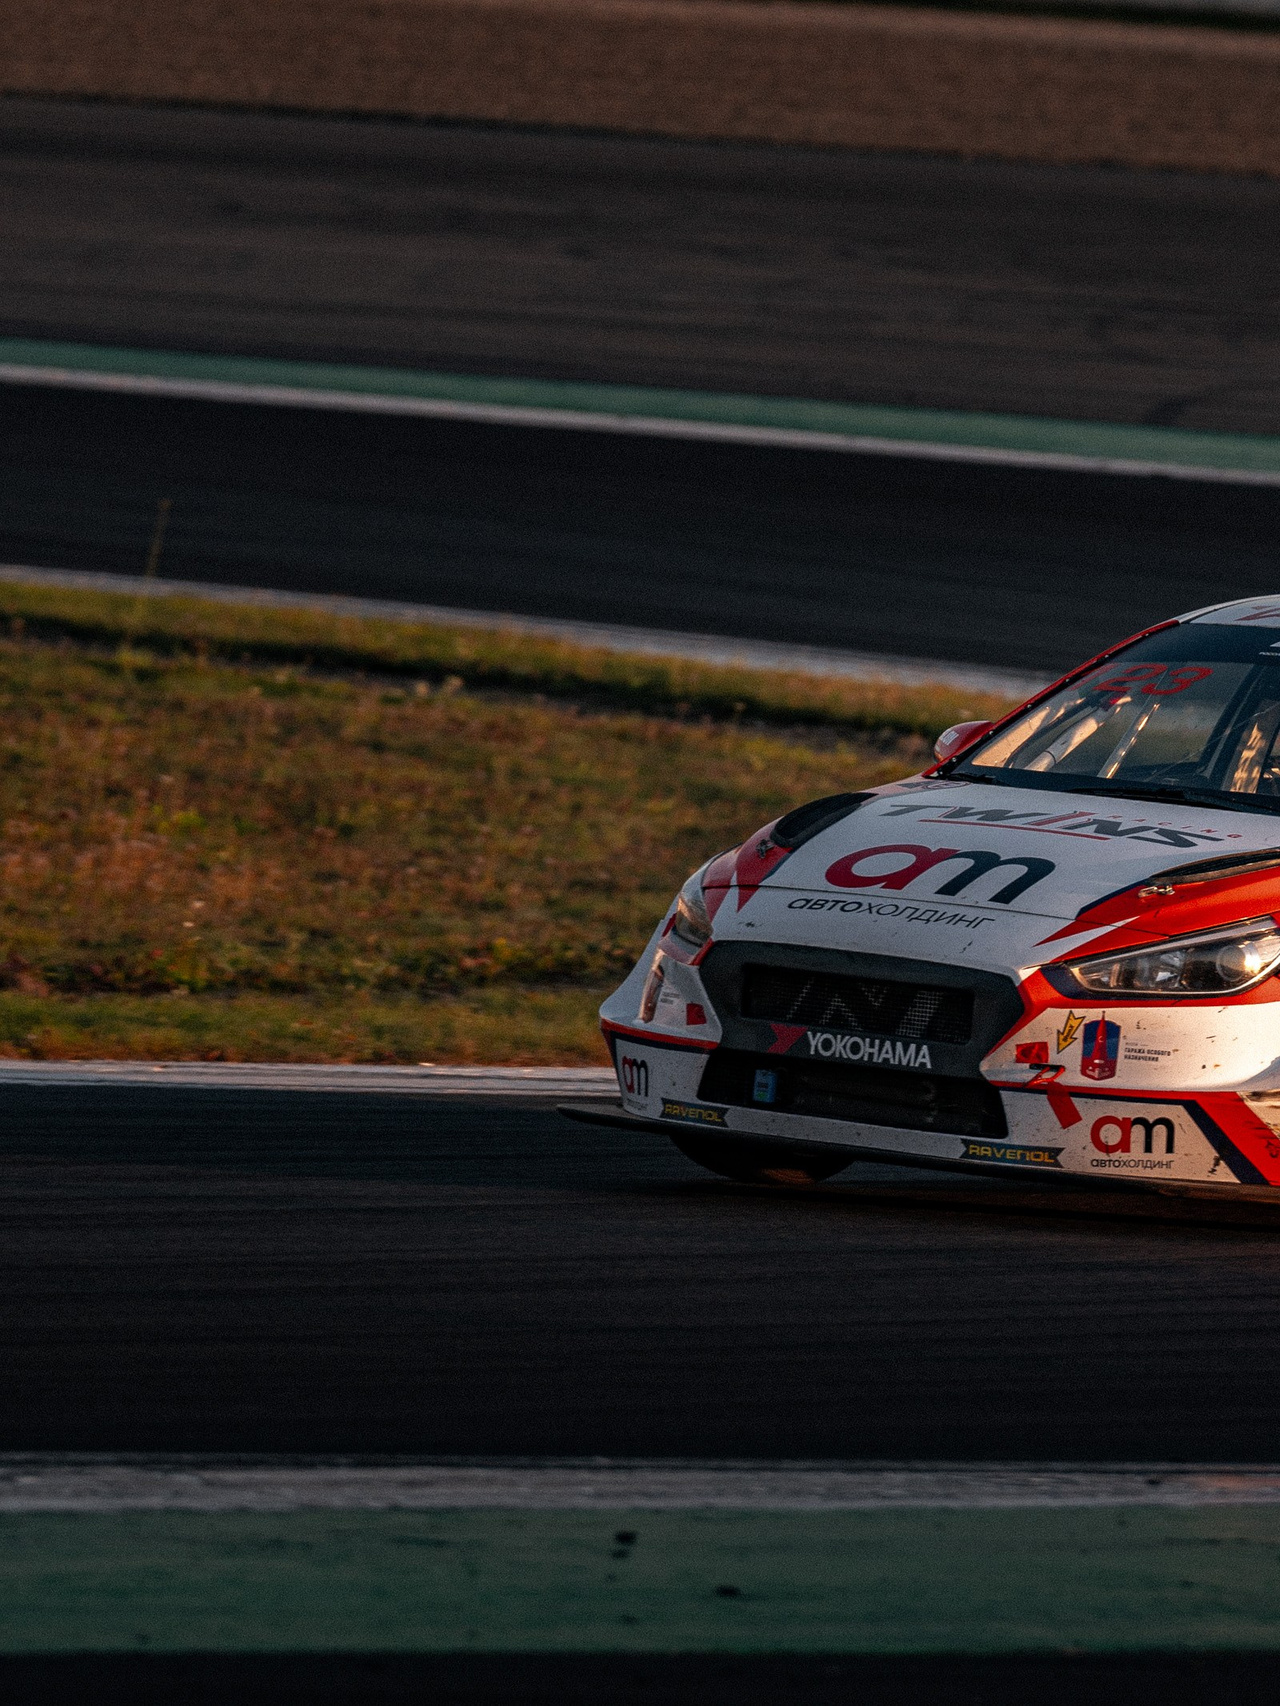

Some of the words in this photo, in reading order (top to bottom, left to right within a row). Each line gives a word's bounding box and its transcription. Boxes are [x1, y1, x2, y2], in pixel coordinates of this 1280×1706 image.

[879, 804, 1225, 848] TWINS
[807, 1030, 933, 1069] YOKOHAMA
[968, 1143, 1055, 1163] RAVENOL
